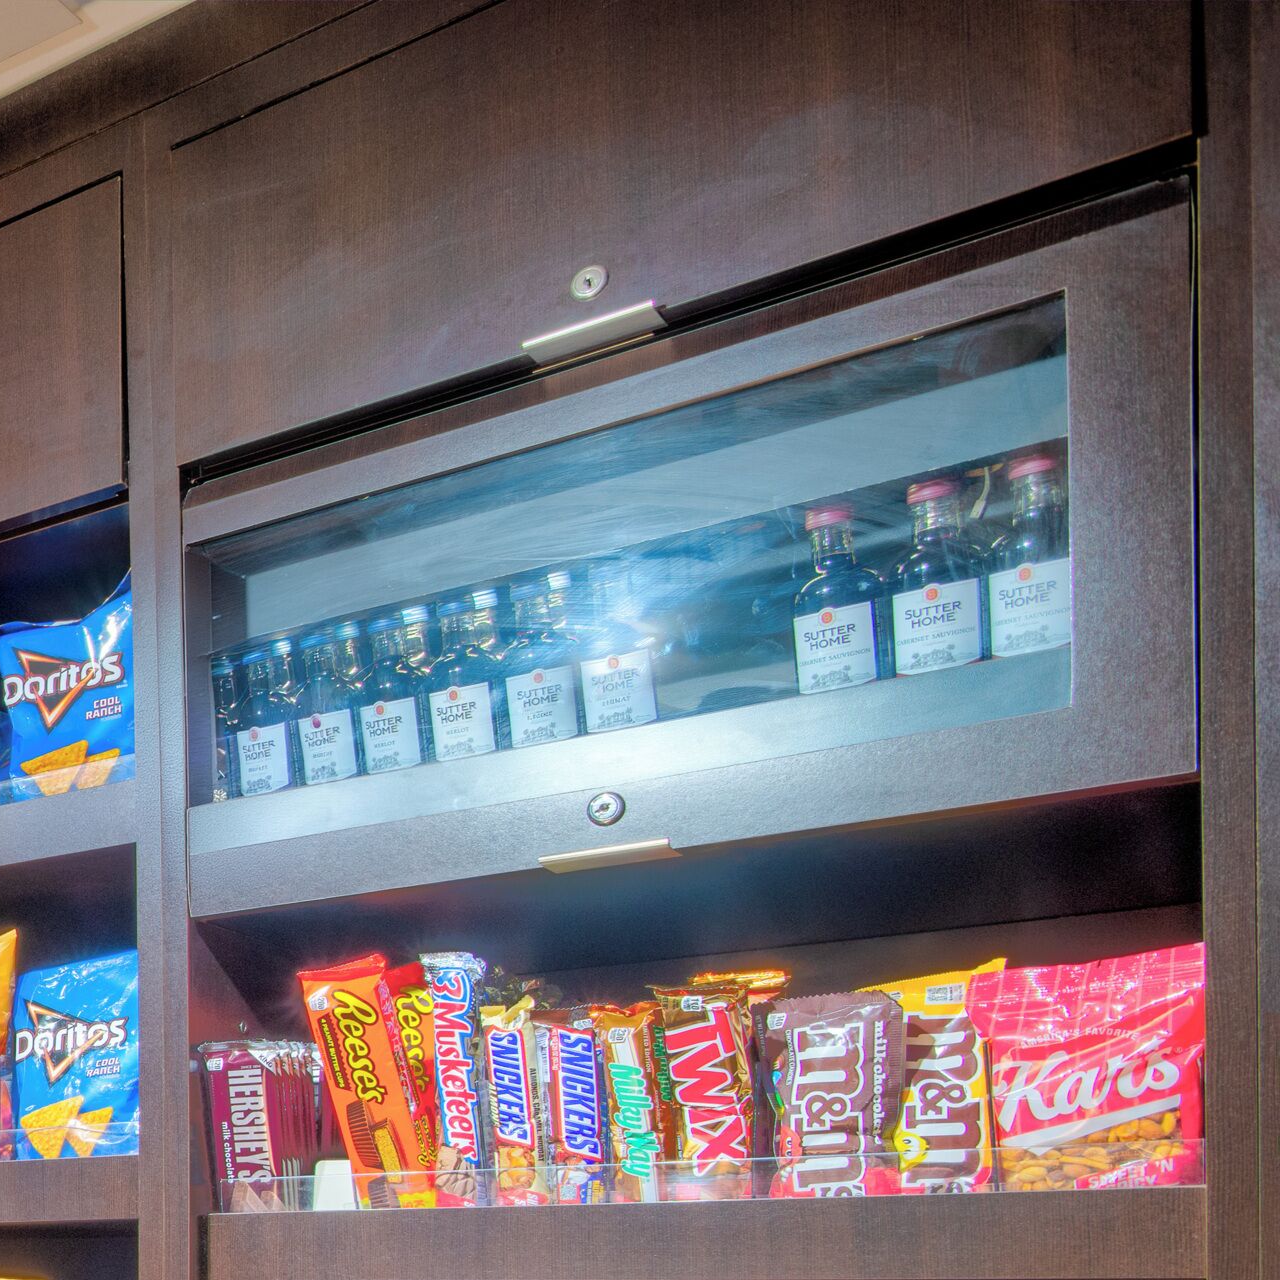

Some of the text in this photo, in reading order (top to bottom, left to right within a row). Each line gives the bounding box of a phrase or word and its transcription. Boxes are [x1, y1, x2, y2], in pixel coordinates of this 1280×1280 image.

[999, 581, 1056, 600] SUTTER
[905, 601, 961, 620] SUTTER
[911, 612, 955, 629] HOME
[804, 623, 856, 642] SUTTER
[932, 626, 976, 641] SAUVIGNON
[809, 635, 851, 651] HOME
[828, 647, 871, 662] SAUVIGNON
[4, 652, 123, 706] Doritos
[517, 684, 561, 700] SUTTER
[93, 697, 121, 709] COOL
[437, 702, 477, 717] SUTTER
[523, 694, 559, 708] HOME
[86, 705, 123, 721] RANCH
[441, 711, 473, 723] HOME
[366, 716, 402, 730] SUTTER
[369, 725, 399, 737] HOME
[15, 1018, 126, 1061] Doritos
[332, 989, 383, 1104] Reese's
[874, 1021, 887, 1062] milk
[1021, 1027, 1139, 1049] AMERICA'S FAVORITE
[87, 1063, 121, 1078] RANCH
[95, 1056, 120, 1068] COOL
[492, 1031, 530, 1142] SNICKERS
[992, 1031, 1181, 1132] Kar's
[559, 1029, 598, 1156] SNICKERS
[228, 1069, 272, 1183] HERSHEY'S
[221, 1121, 234, 1184] milk chocolate
